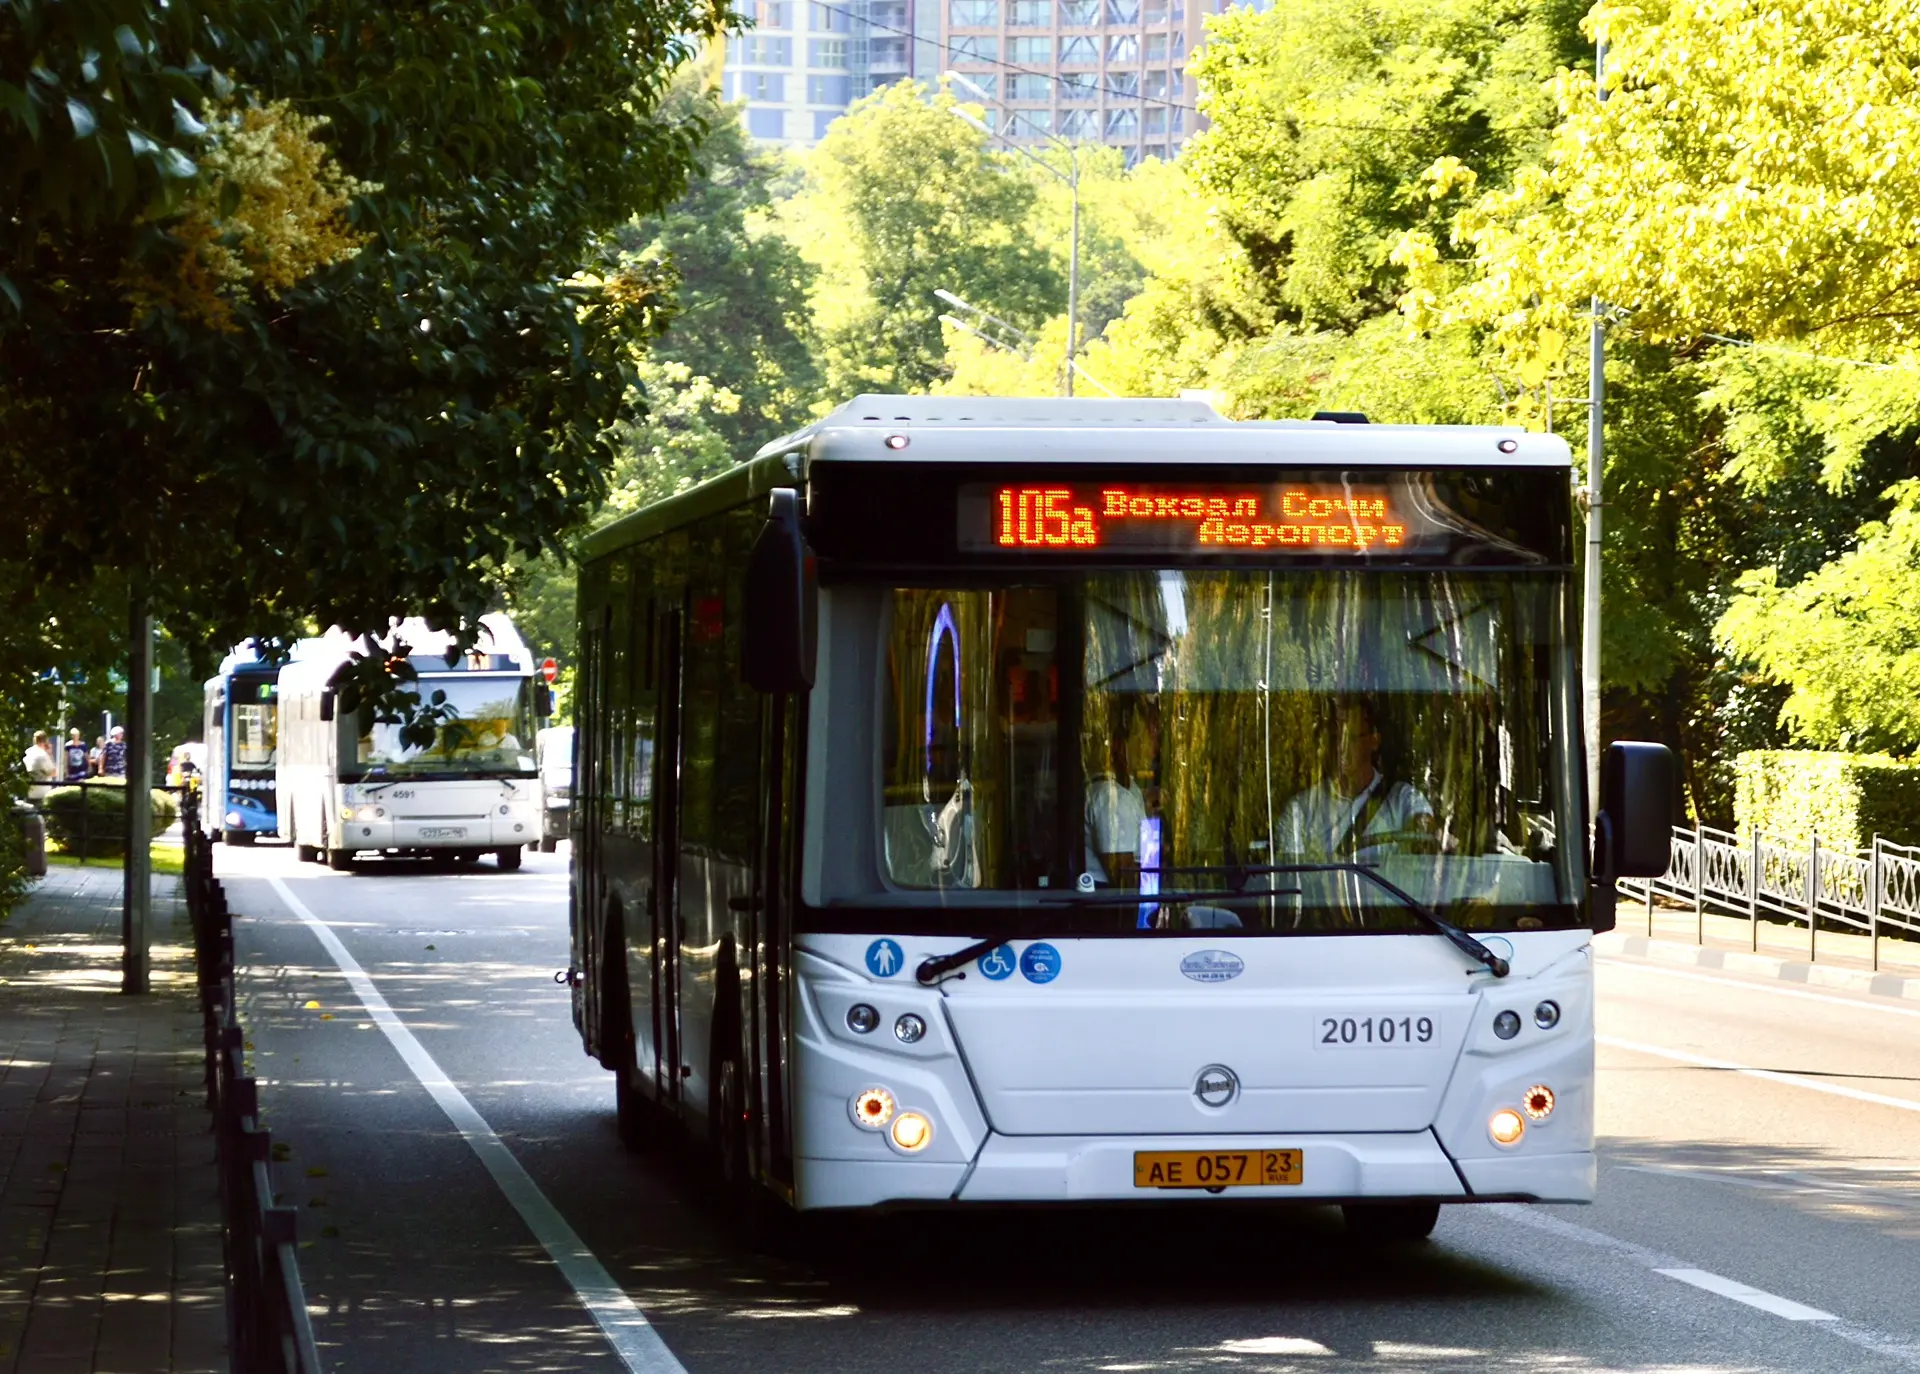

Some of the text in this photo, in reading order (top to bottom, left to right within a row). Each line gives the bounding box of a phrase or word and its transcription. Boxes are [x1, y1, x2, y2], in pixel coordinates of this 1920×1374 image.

[999, 489, 1385, 545] 105а Вокзал Сочи
[1199, 517, 1404, 547] Аэропорт
[392, 789, 416, 799] 4591
[1321, 1016, 1434, 1043] 201019
[1149, 1153, 1292, 1182] AE 057 23
[1268, 1173, 1289, 1182] RUS
